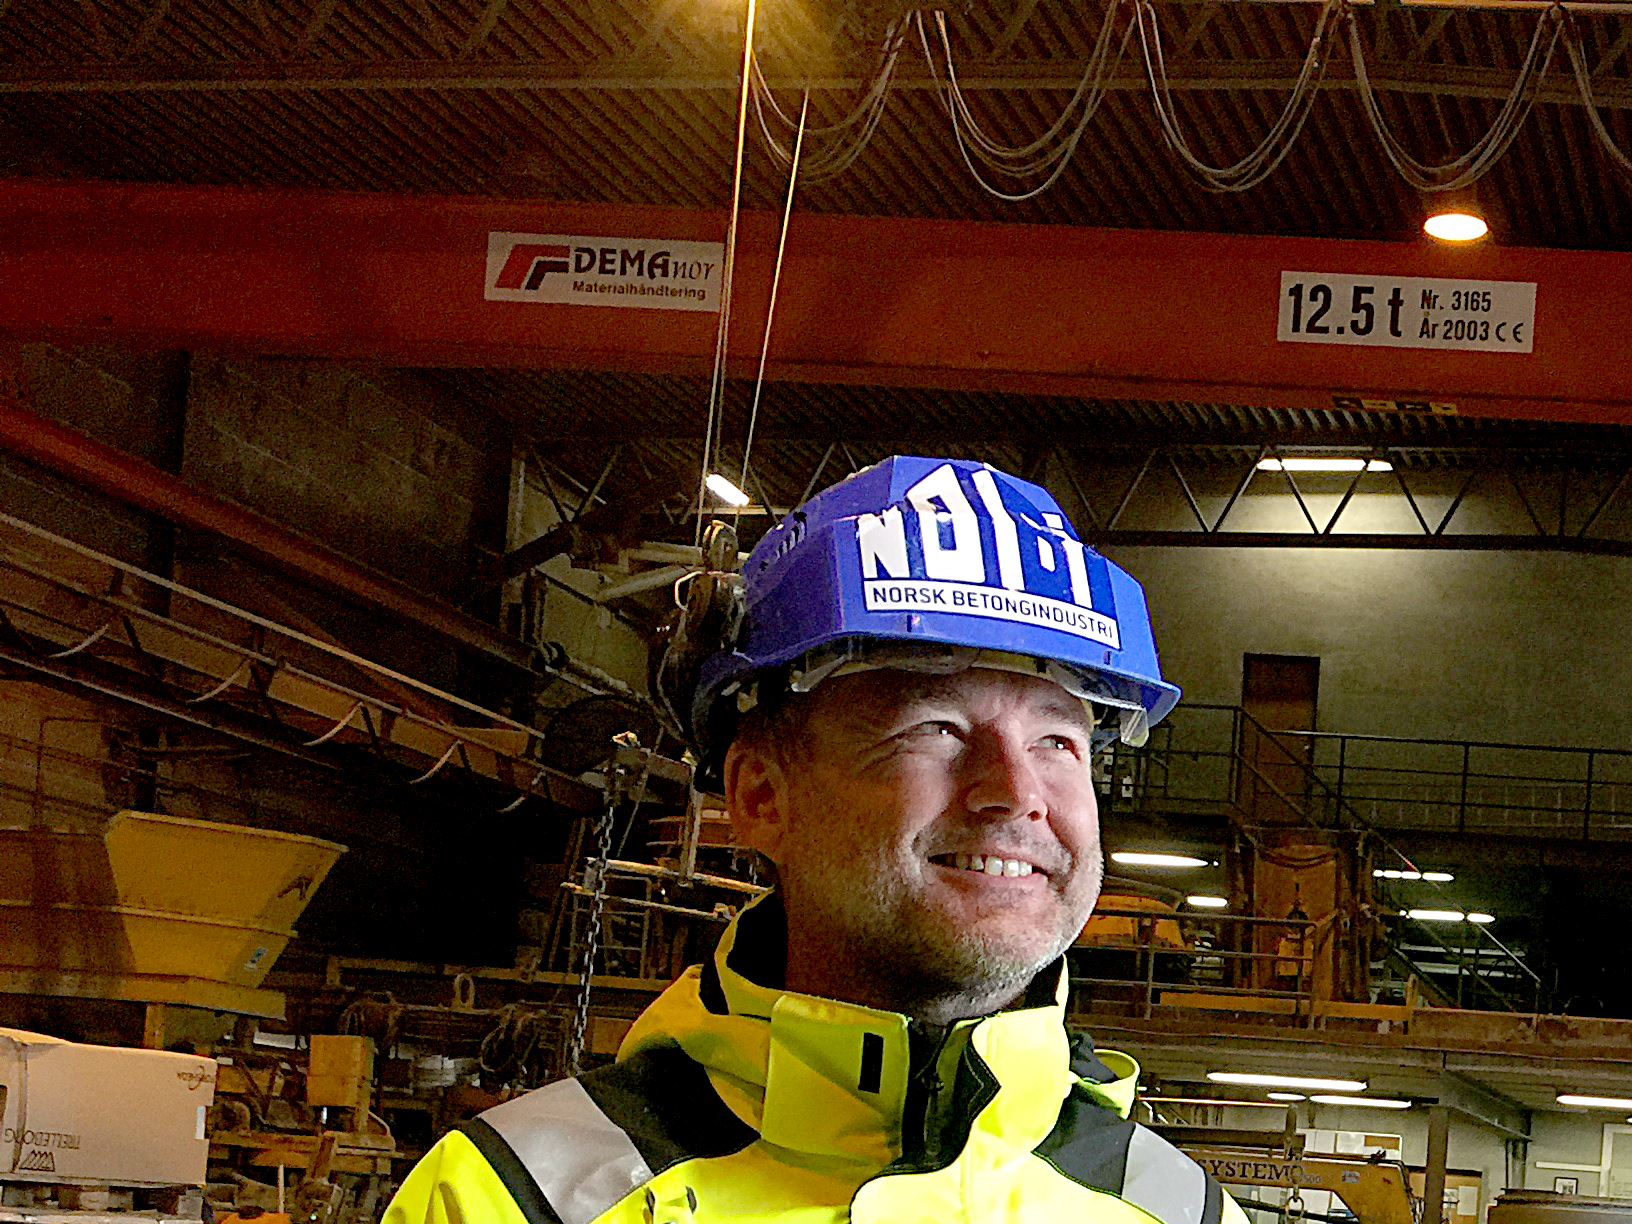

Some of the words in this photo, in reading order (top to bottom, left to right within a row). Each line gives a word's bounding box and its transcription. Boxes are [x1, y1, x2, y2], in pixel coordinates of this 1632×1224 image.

[1288, 283, 1375, 336] 12.5
[1387, 287, 1405, 338] t
[1420, 289, 1445, 310] Nr.
[1451, 290, 1491, 312] 3165
[1442, 320, 1490, 341] 2003
[873, 586, 946, 605] NORSK
[952, 590, 1113, 639] BETONGINDUSTRI
